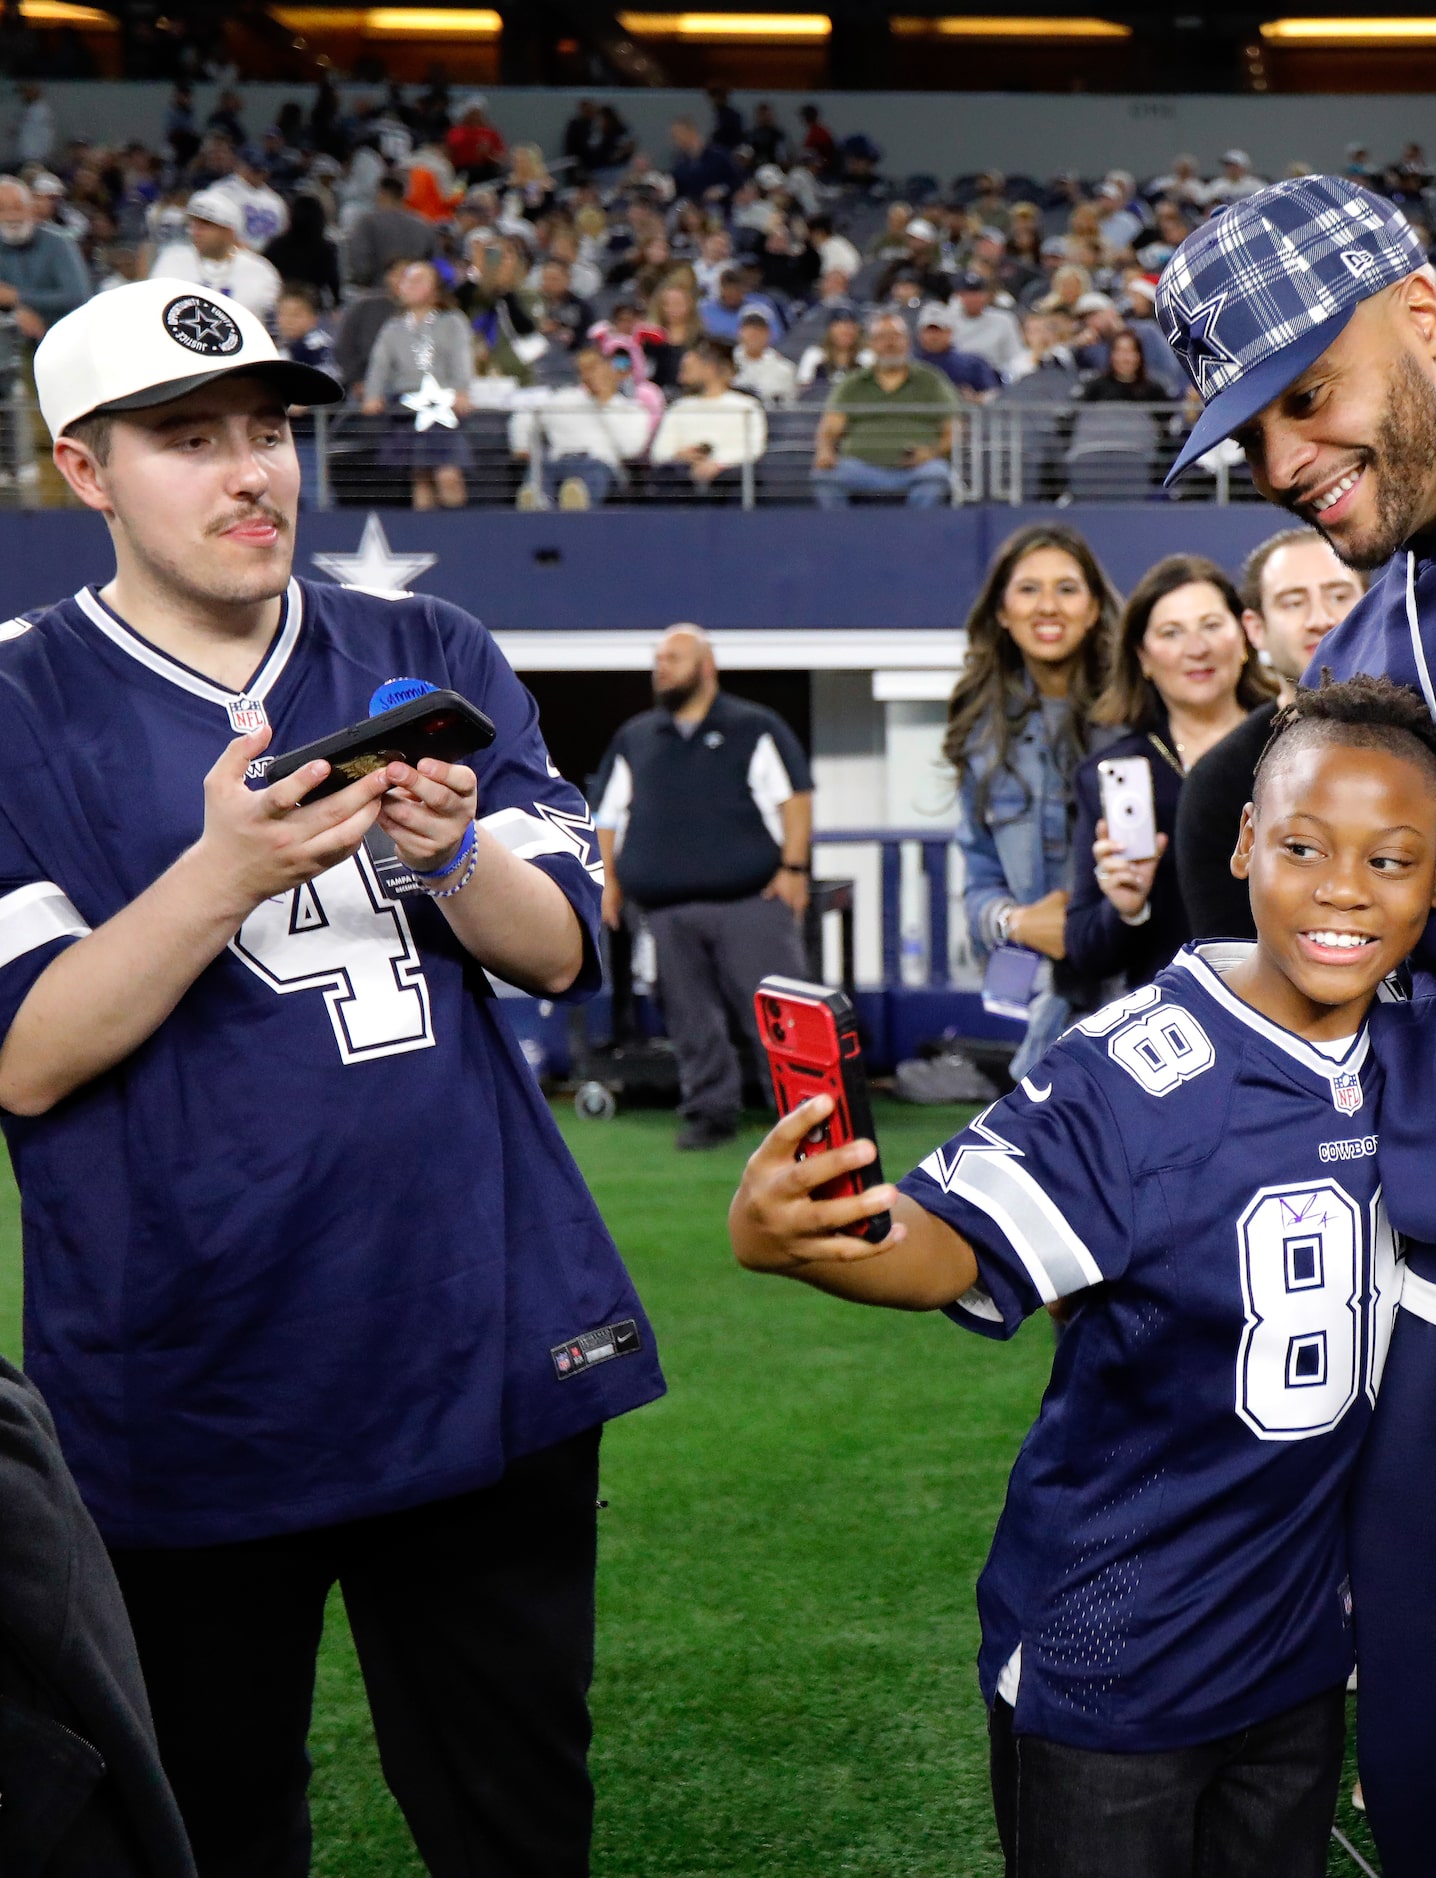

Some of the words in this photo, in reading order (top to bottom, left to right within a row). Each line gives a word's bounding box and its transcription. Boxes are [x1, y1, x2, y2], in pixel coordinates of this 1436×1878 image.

[175, 331, 208, 352] JUSTICE
[235, 711, 263, 728] NFL
[386, 873, 412, 888] TAMPA
[227, 842, 436, 1066] 4
[1338, 1087, 1359, 1107] NFL
